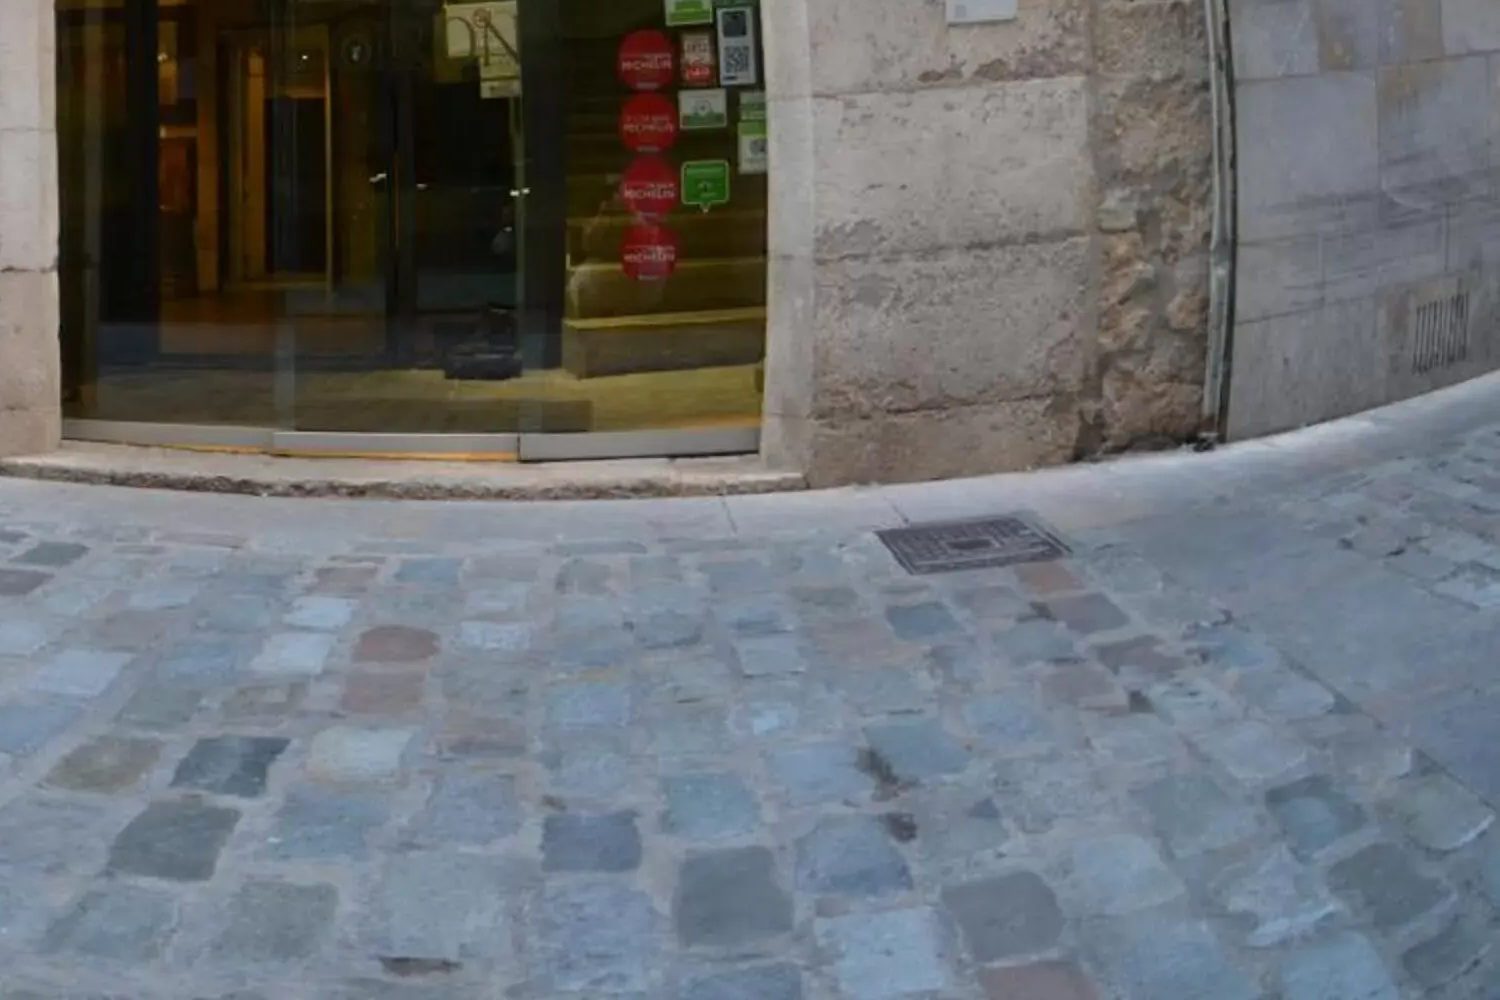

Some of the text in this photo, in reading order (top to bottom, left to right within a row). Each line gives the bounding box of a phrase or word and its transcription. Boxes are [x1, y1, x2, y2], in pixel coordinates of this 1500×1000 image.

[621, 59, 672, 71] MICHELIN
[624, 187, 675, 199] MICHELIN
[624, 252, 675, 263] MICHELIN
